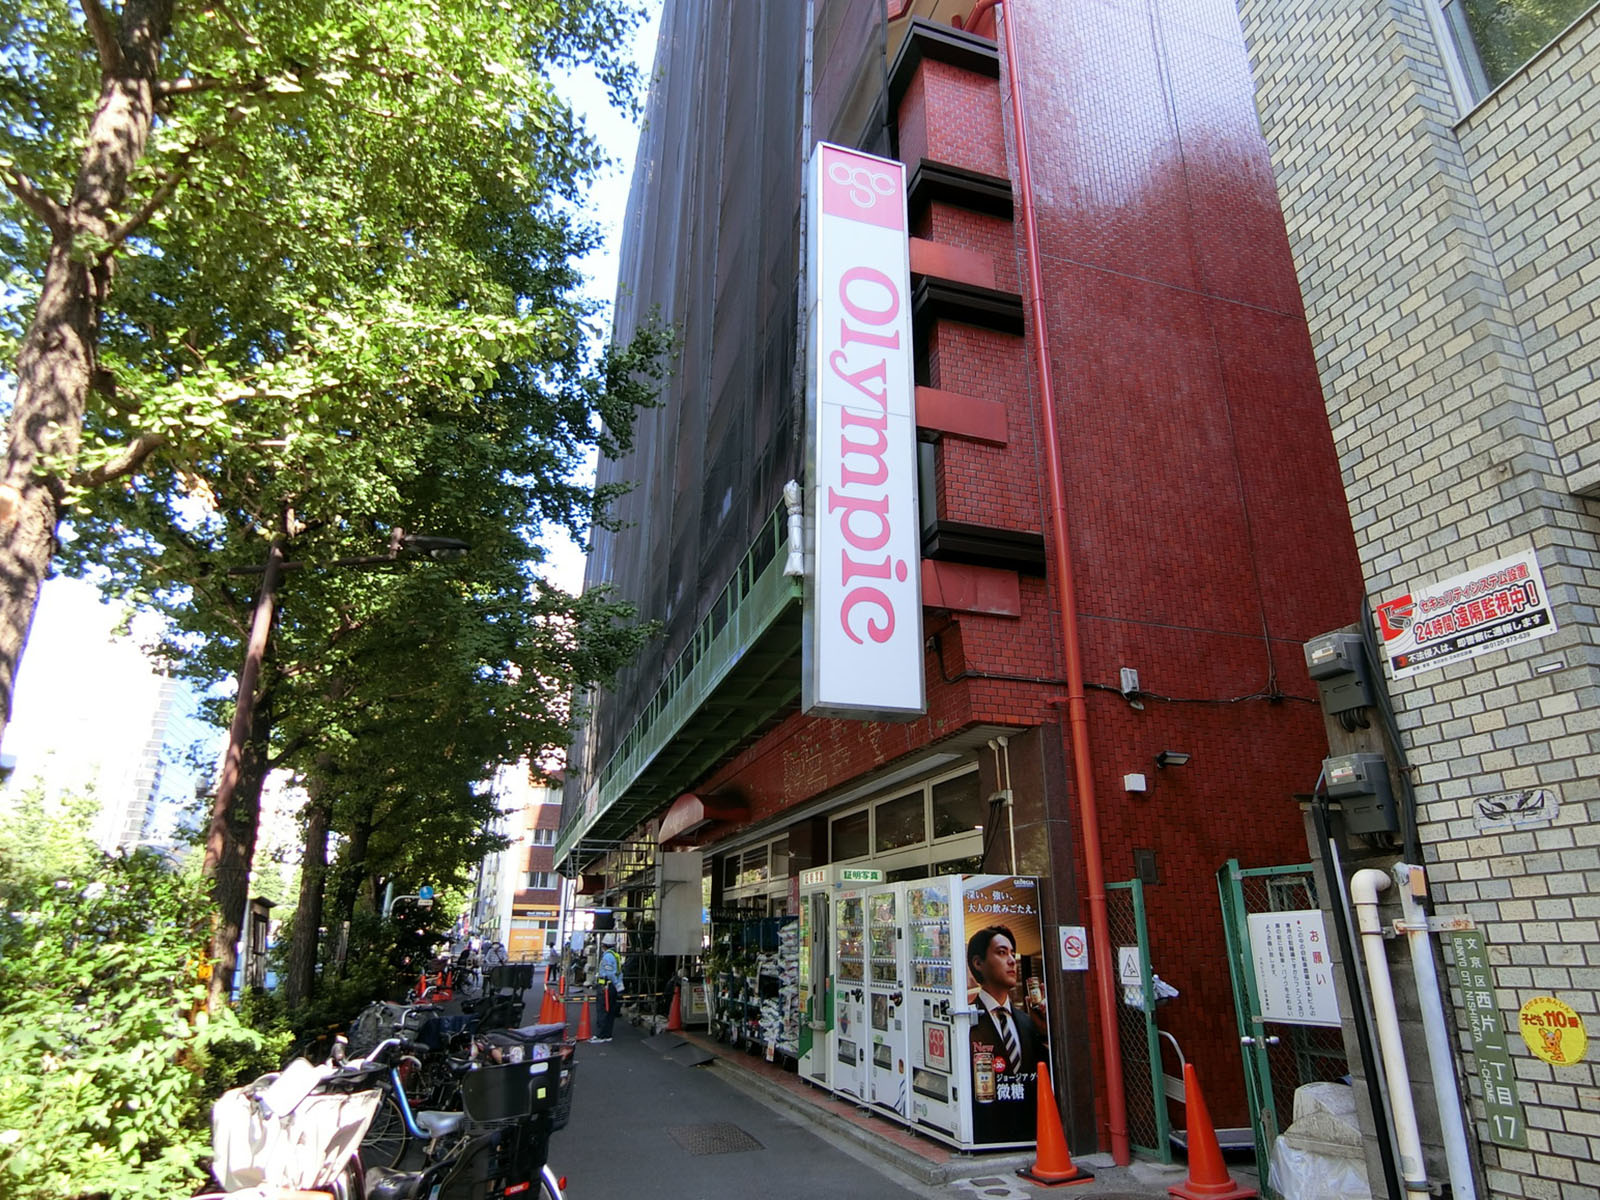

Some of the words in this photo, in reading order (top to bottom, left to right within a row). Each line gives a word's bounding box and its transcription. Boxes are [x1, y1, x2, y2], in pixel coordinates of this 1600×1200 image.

[829, 266, 907, 645] Olympic
[1420, 563, 1530, 613] セキュリティシステム設置
[844, 870, 878, 880] 証明写真
[968, 903, 1037, 914] 大人の飲みごたえ。
[1309, 930, 1327, 986] お願い
[1453, 937, 1467, 967] BUNKYO
[1461, 970, 1473, 987] CITY
[1464, 990, 1483, 1042] NISHIKATA
[996, 1072, 1028, 1082] ジョージア
[996, 1083, 1024, 1100] 微糖
[1493, 1114, 1516, 1140] 17
